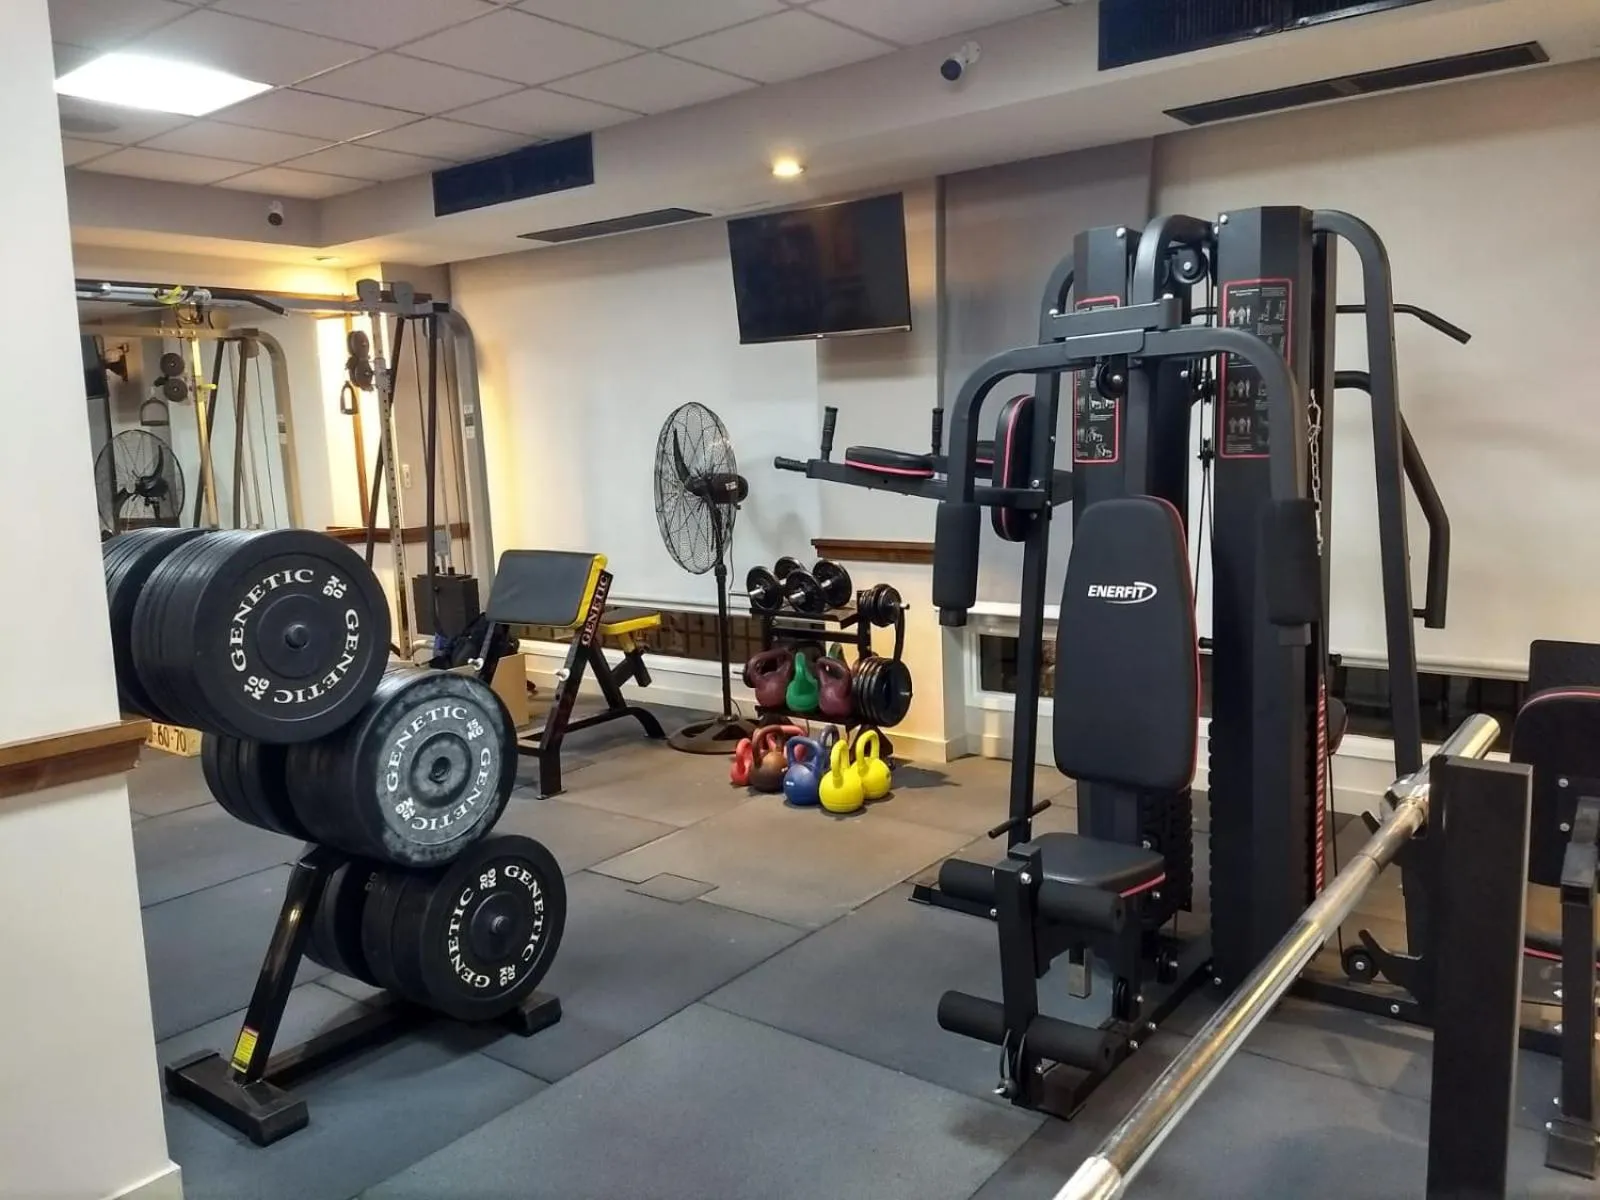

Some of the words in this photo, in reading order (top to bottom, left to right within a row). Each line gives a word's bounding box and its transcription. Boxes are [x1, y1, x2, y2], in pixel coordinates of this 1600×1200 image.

[323, 575, 340, 597] KG
[334, 583, 347, 599] 10
[1087, 584, 1148, 599] ENERFIT
[230, 568, 314, 672] GENETIC
[581, 575, 607, 647] GENETIC
[274, 609, 359, 704] GENETIC
[244, 676, 258, 692] 10
[252, 678, 270, 700] KG
[466, 718, 479, 730] 15
[467, 726, 484, 740] KG
[387, 705, 467, 792] GENETIC
[411, 748, 491, 830] GENETIC
[395, 797, 413, 814] KG
[480, 874, 488, 890] 20
[488, 868, 497, 888] KG
[504, 865, 544, 962] GENETIC
[448, 888, 491, 988] GENETIC
[499, 966, 507, 986] KG
[507, 964, 515, 980] 20
